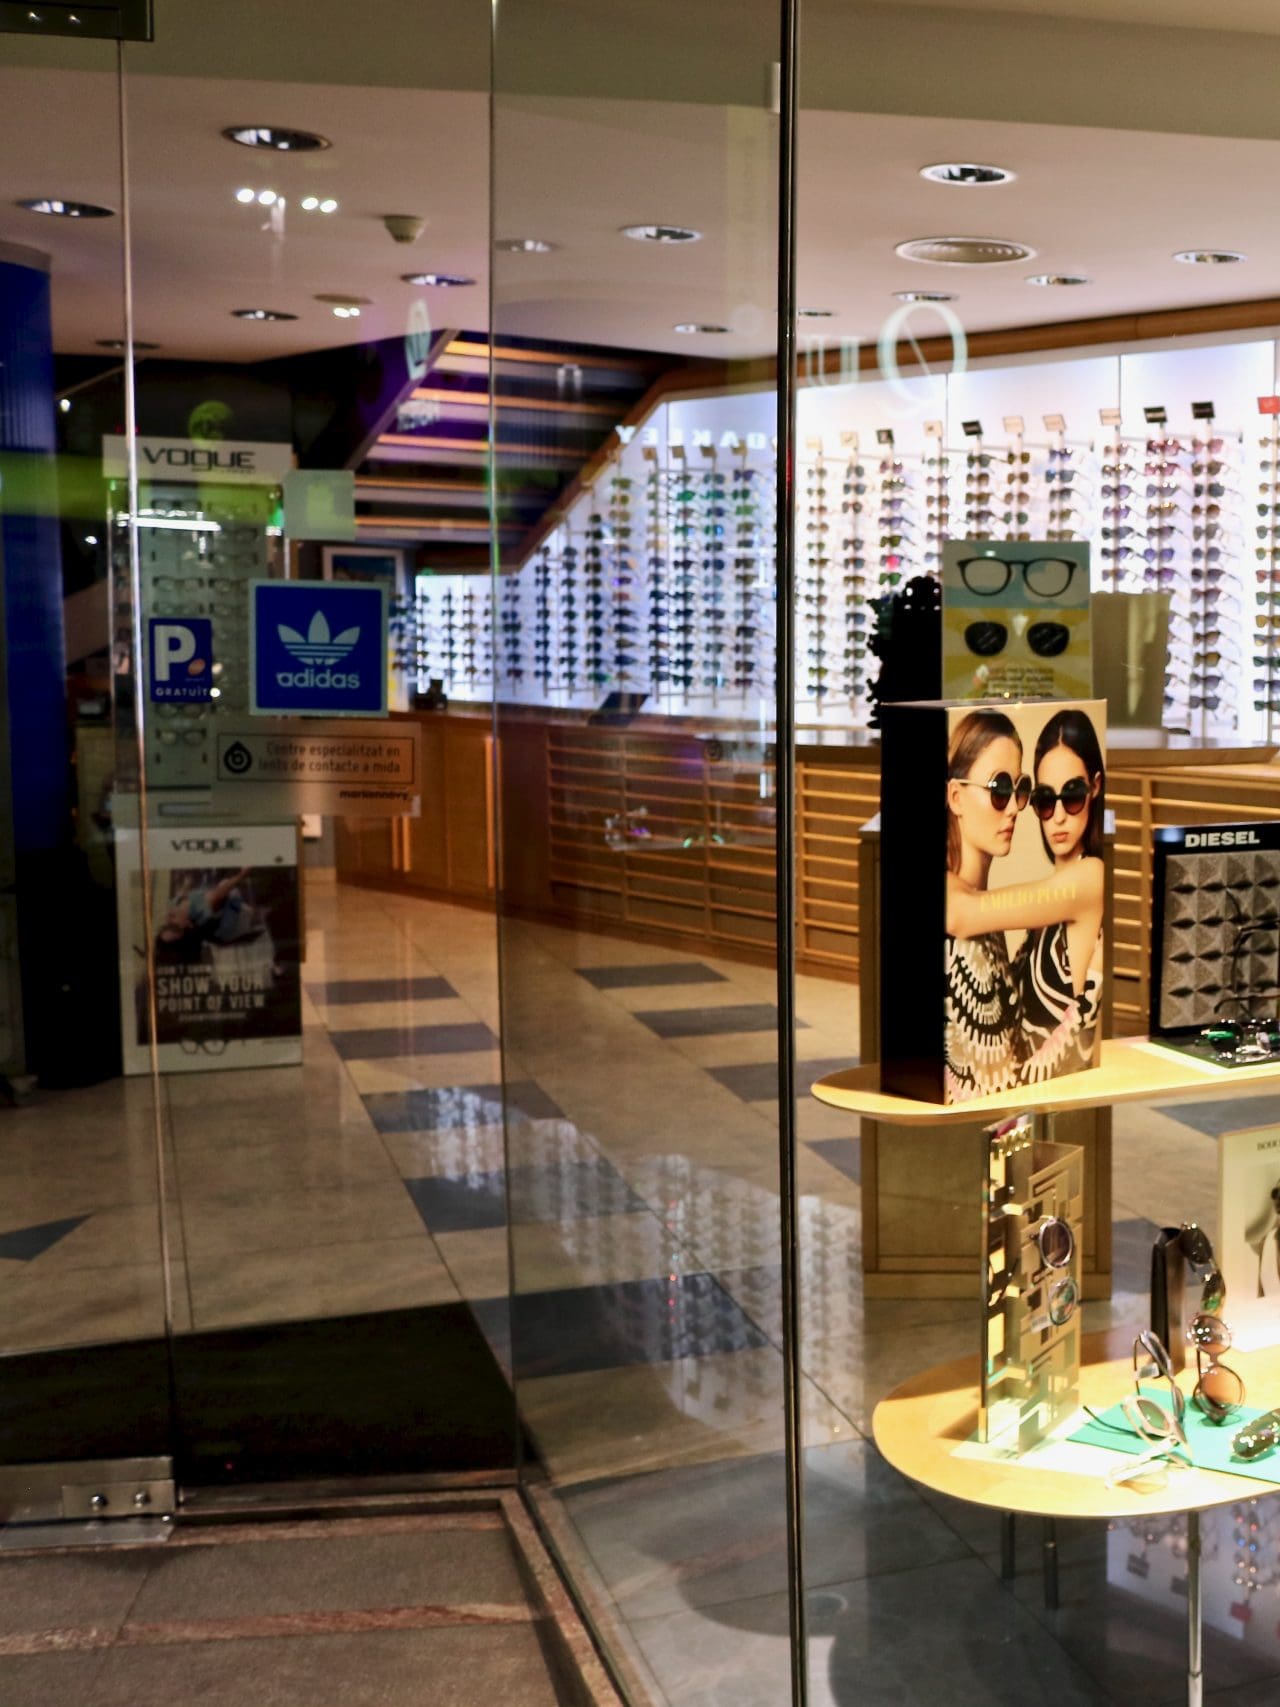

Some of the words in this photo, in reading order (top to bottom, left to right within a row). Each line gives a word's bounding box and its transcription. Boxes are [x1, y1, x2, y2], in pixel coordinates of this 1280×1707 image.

[142, 446, 256, 472] VOGUE
[276, 668, 360, 689] adidas
[309, 742, 384, 758] especialitzat
[386, 747, 400, 756] en
[291, 759, 305, 771] de
[308, 759, 360, 772] contacte
[372, 760, 401, 773] mida
[171, 837, 243, 853] VOGUE
[1185, 831, 1260, 848] DIESEL
[157, 976, 210, 996] SHOW
[217, 974, 265, 993] YOUR
[157, 995, 201, 1013] POINT
[206, 995, 223, 1011] OF
[229, 994, 266, 1009] VIEW
